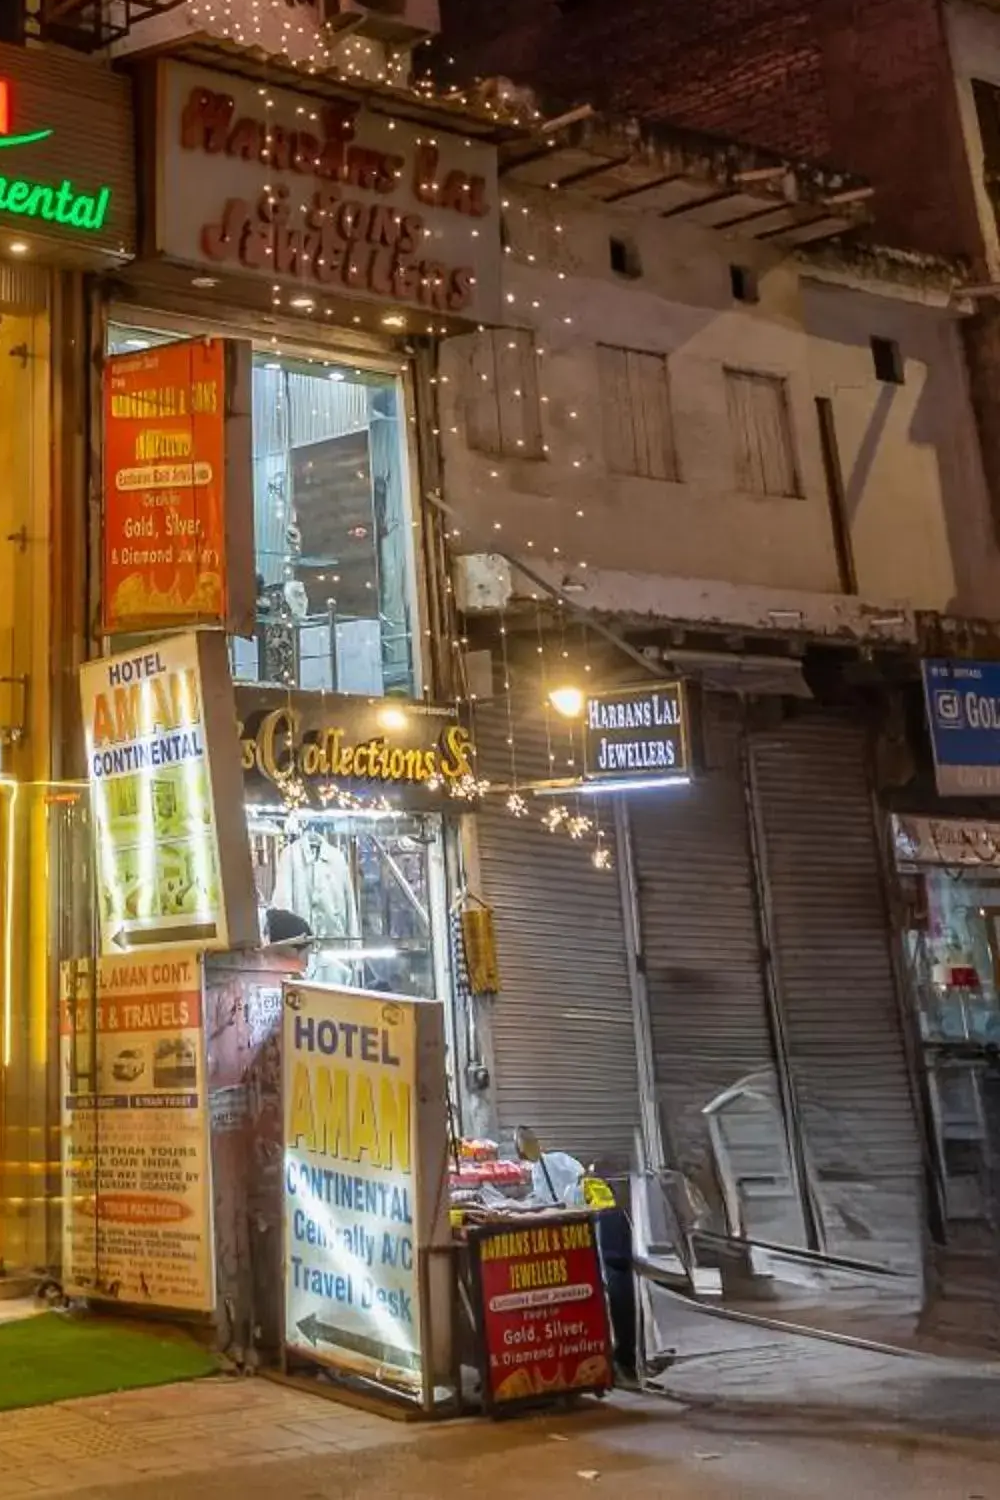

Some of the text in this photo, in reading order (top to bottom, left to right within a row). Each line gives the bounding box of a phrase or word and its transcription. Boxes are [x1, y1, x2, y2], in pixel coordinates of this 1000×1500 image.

[124, 516, 159, 539] Gold,
[121, 546, 173, 565] Diamond
[108, 652, 167, 686] HOTEL
[93, 668, 200, 748] AMAN
[588, 694, 681, 730] HARBANS LAL
[93, 731, 204, 777] CONTINENTAL
[256, 707, 434, 782] Collections
[599, 737, 675, 769] JEWELLERS
[110, 965, 148, 988] AMAN
[151, 961, 192, 984] CONT.
[107, 1005, 119, 1028] &
[124, 1001, 190, 1028] TRAVELS
[295, 1016, 400, 1066] HOTEL
[288, 1060, 412, 1175] AMAN
[287, 1162, 412, 1225] CONTINENTAL
[382, 1232, 413, 1271] A/C
[563, 1223, 592, 1249] SONS
[290, 1256, 353, 1305] Travel
[510, 1257, 568, 1289] JEWELLERS
[503, 1320, 589, 1345] Gold, Silver,
